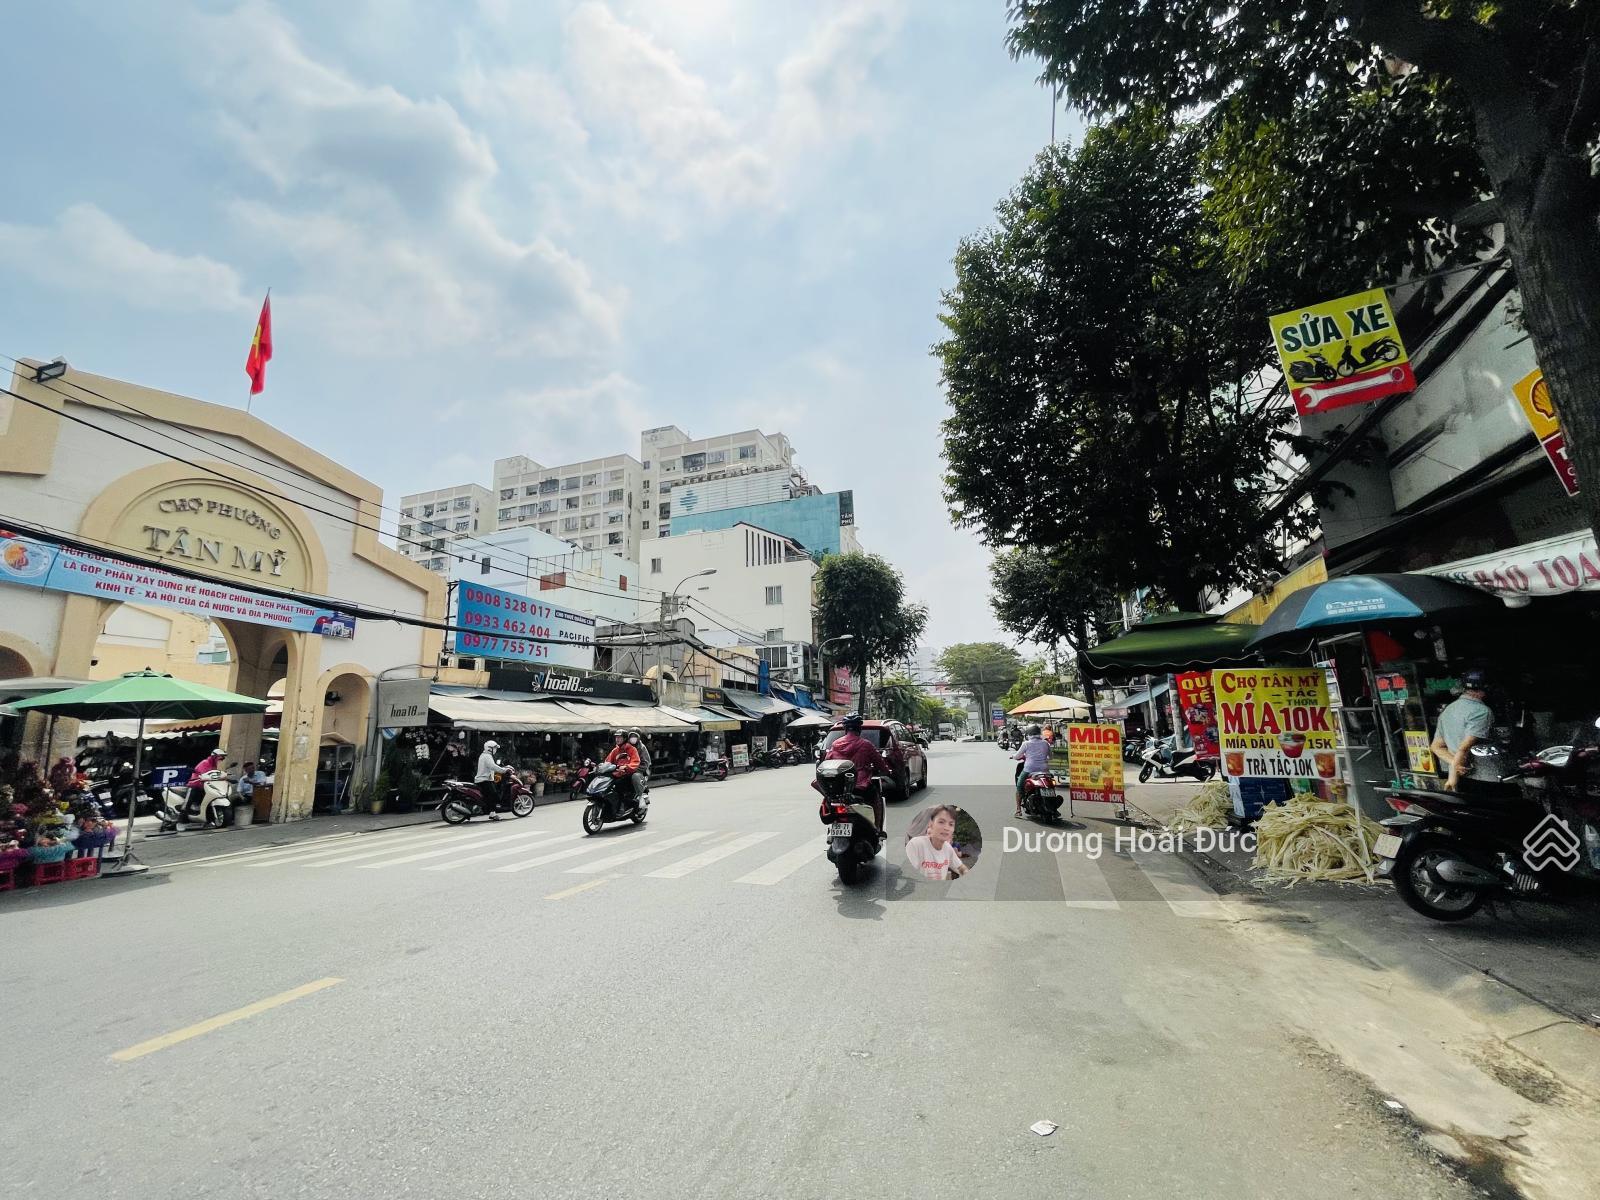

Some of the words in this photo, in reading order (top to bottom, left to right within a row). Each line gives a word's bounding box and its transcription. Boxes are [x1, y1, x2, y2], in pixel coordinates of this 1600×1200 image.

[1281, 313, 1344, 352] SỬA
[1345, 303, 1390, 336] XE
[159, 498, 203, 514] CHỢ
[207, 501, 281, 539] PHƯỜNG
[142, 525, 224, 563] TÂN
[231, 545, 288, 576] MỸ
[95, 580, 121, 592] KINH
[467, 588, 500, 607] 0908
[504, 597, 527, 613] 328
[530, 604, 551, 619] 017
[465, 611, 499, 630] 0933
[503, 619, 526, 634] 462
[529, 624, 550, 639] 404
[560, 630, 590, 642] PACIFIC
[463, 633, 498, 650] 0977
[502, 637, 525, 654] 755
[528, 643, 548, 658] 751
[544, 670, 594, 692] hoa18.com
[1221, 672, 1258, 693] CHỢ
[1261, 673, 1293, 688] TÂN
[1298, 672, 1321, 687] MỸ
[1221, 692, 1281, 735] MÍA
[1280, 706, 1330, 732] 10K
[1070, 725, 1120, 744] MÍA
[1226, 736, 1247, 749] MÍA
[1308, 738, 1333, 749] 15K
[1246, 754, 1269, 776] TRÀ
[1270, 751, 1291, 776] TẮC
[1294, 759, 1314, 776] 10K
[162, 769, 179, 783] P
[1109, 793, 1123, 803] 10K
